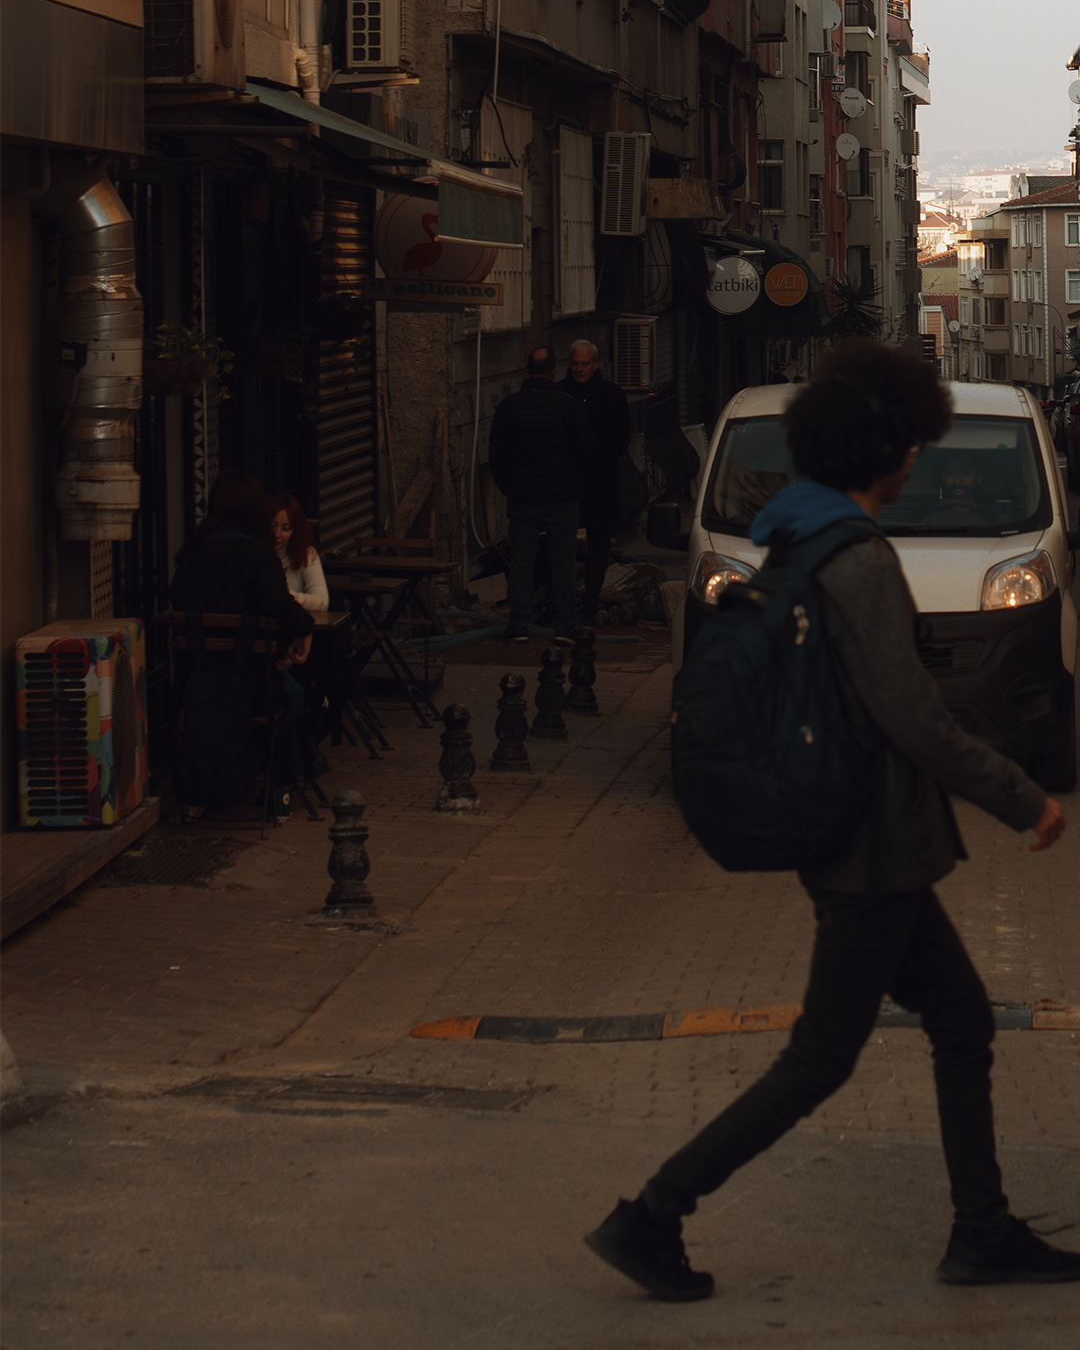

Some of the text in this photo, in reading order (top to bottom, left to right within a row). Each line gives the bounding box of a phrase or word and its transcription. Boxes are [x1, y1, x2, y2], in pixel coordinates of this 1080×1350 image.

[369, 280, 497, 298] il pellicano
[708, 277, 759, 292] tatbiki
